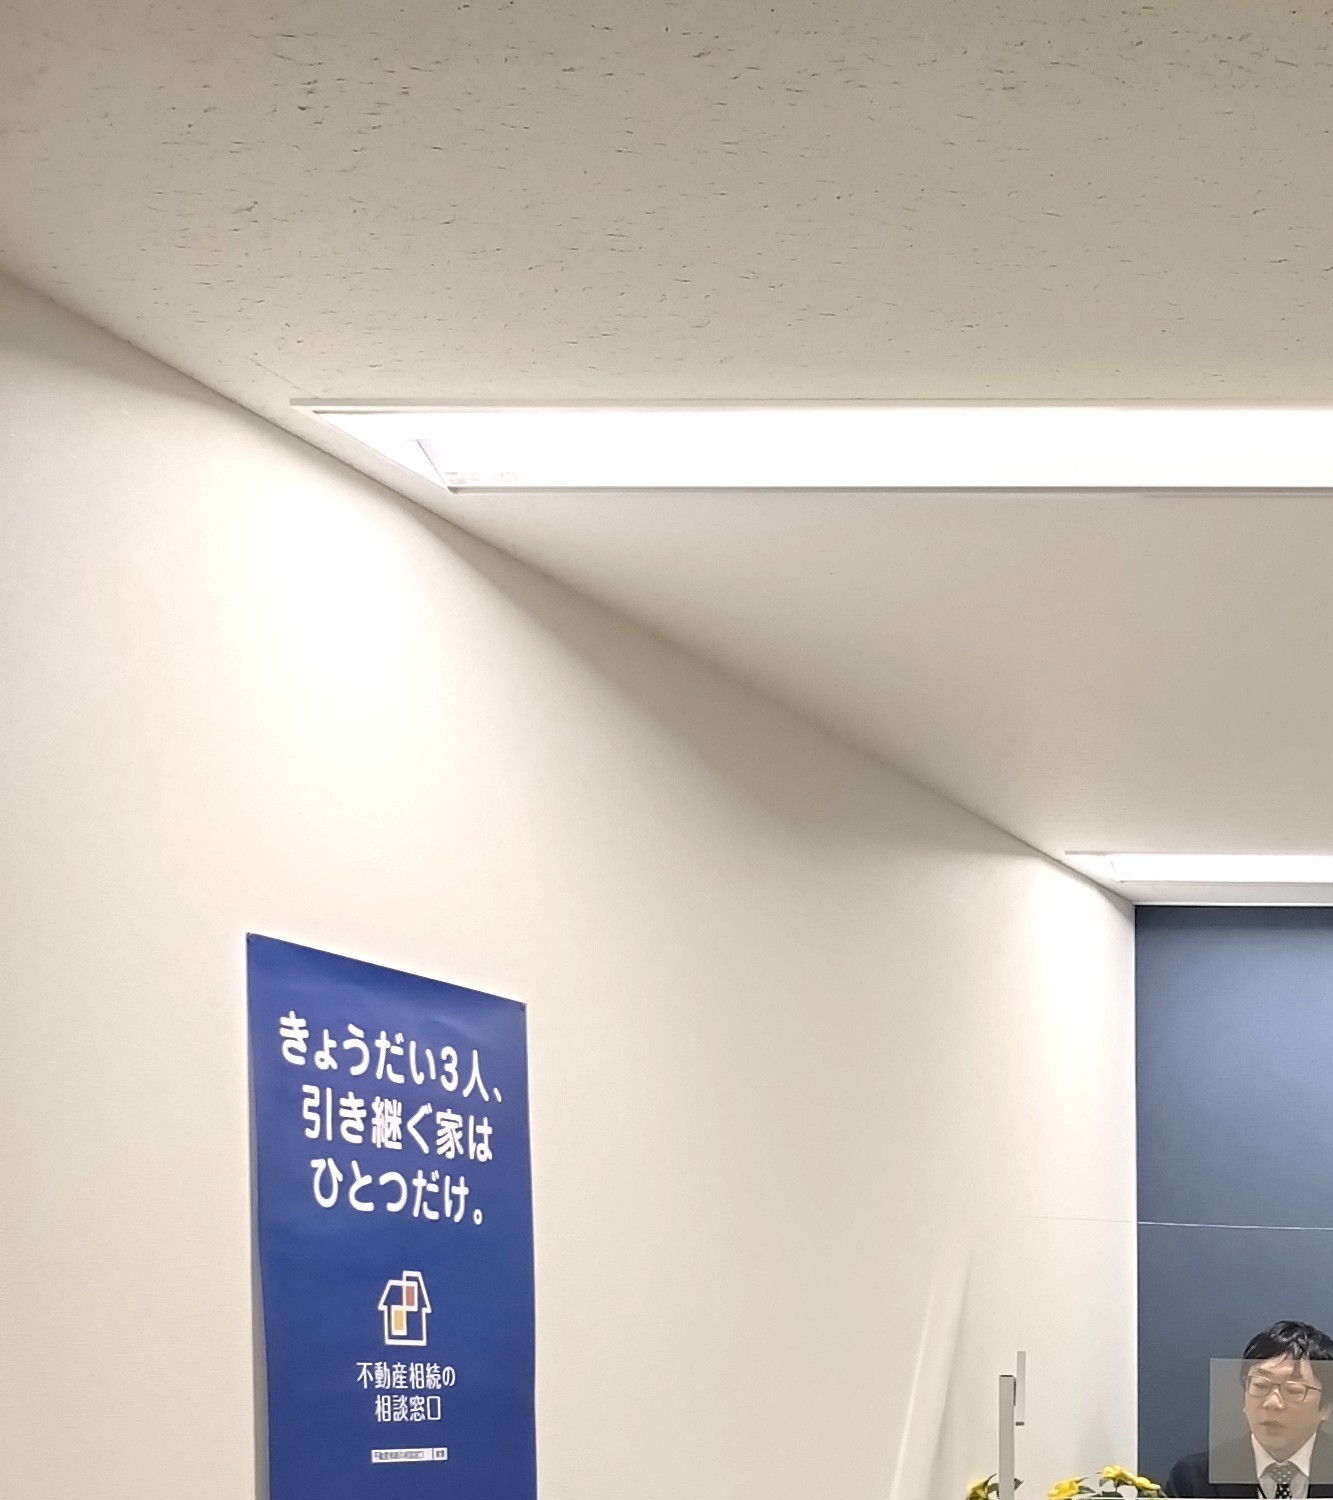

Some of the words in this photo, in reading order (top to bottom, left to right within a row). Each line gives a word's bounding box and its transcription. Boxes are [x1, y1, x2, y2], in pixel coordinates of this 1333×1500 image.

[279, 1010, 502, 1102] きょうだい3人、
[302, 1084, 493, 1162] 引き継ぐ家は
[311, 1157, 483, 1225] ひとつだけ。
[356, 1362, 455, 1389] 不動産相続の
[375, 1395, 441, 1422] 相談窓口
